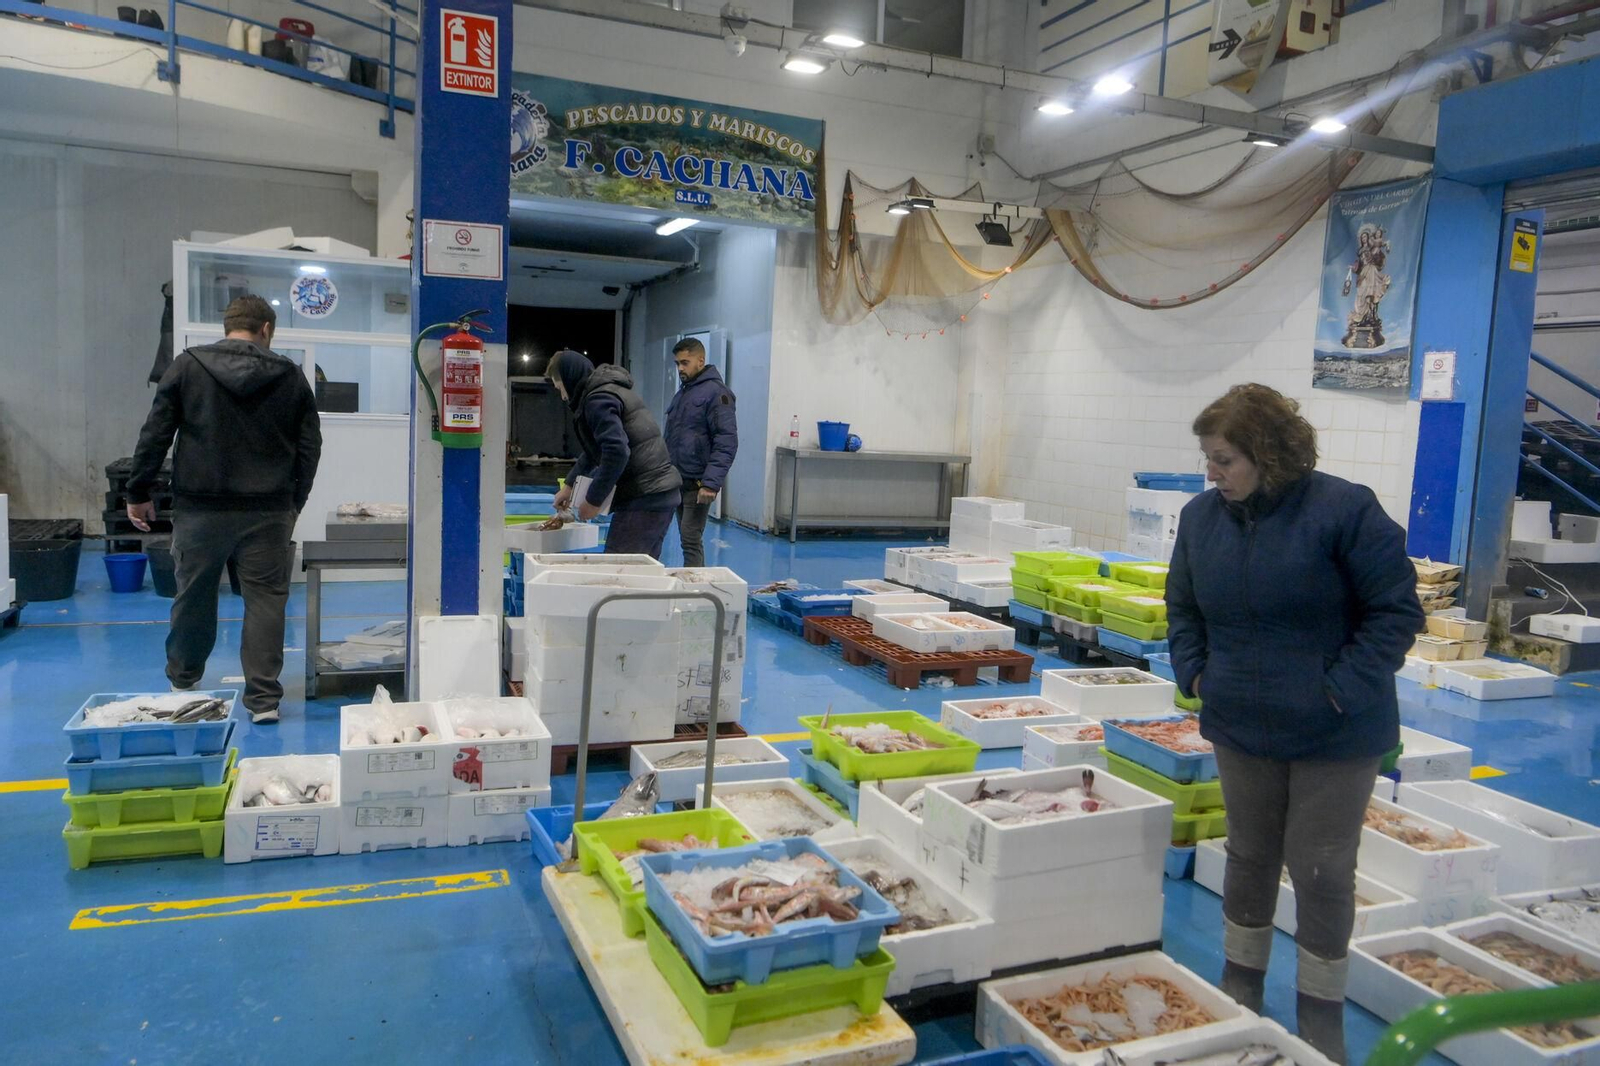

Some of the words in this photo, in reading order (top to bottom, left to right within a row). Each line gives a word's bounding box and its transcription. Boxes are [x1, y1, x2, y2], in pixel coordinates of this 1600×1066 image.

[446, 71, 492, 90] EXTINTOR
[565, 104, 685, 130] PESCADOS
[690, 108, 704, 128] Y
[708, 113, 817, 165] MARISCOS
[563, 138, 606, 174] F.
[613, 145, 816, 201] CACHANA
[676, 190, 709, 204] S.L.U.
[452, 413, 474, 421] PRS
